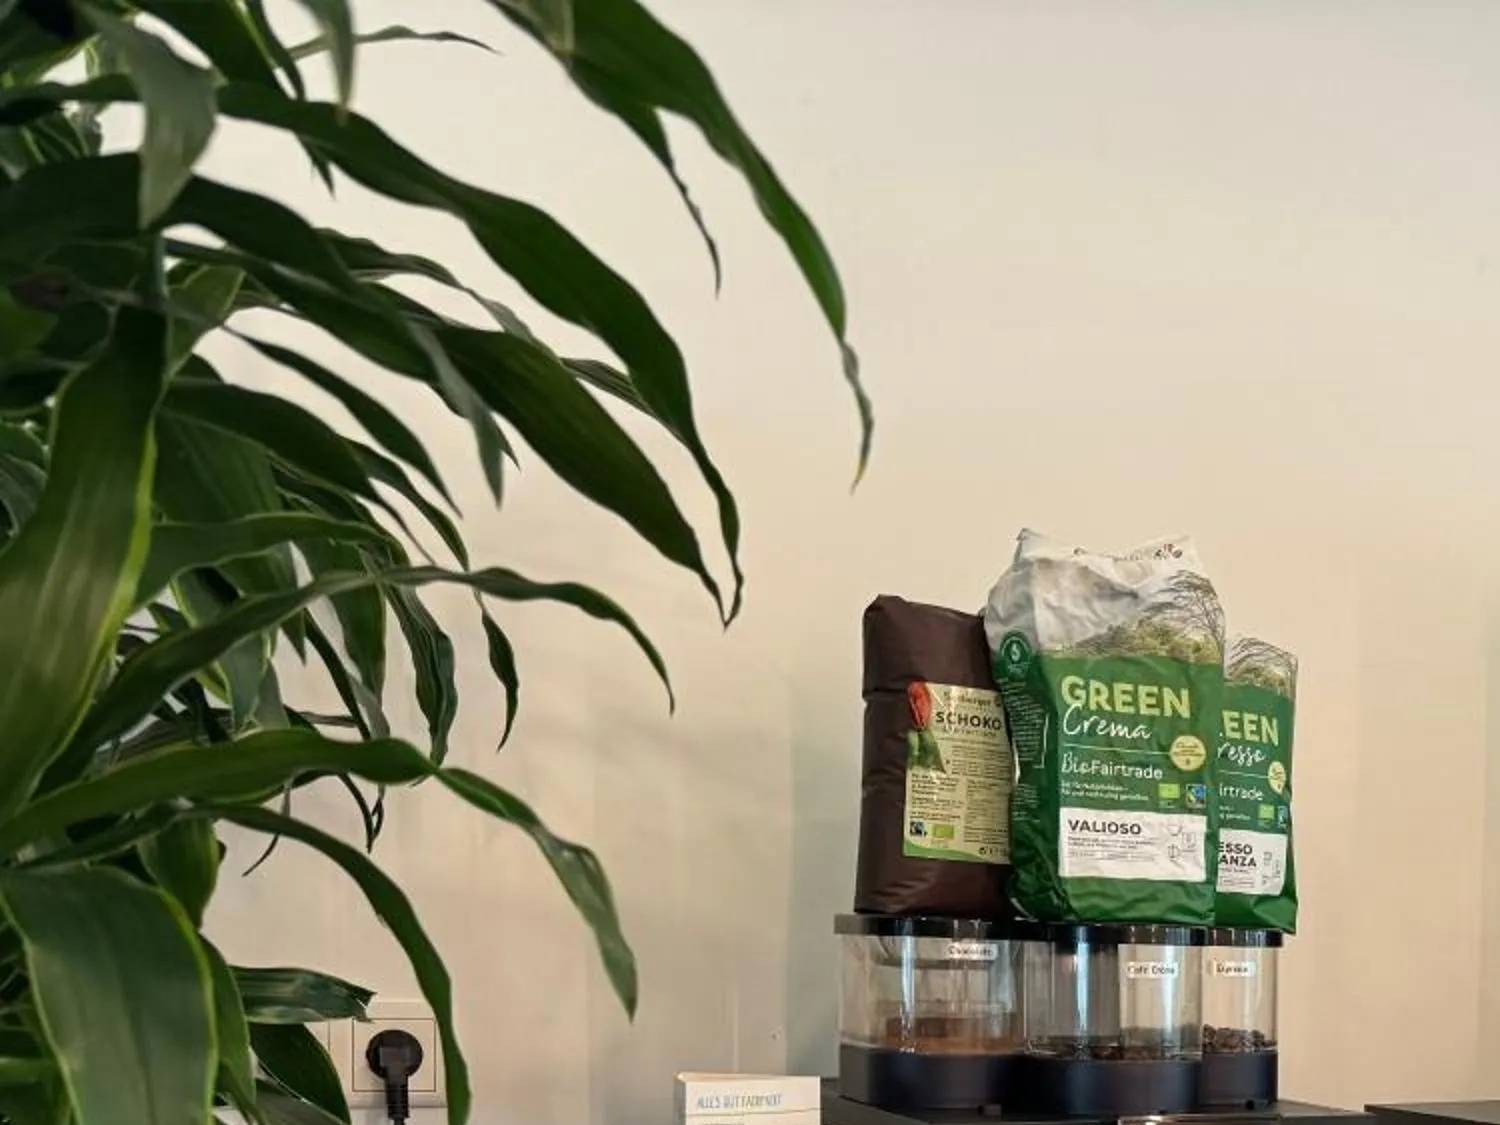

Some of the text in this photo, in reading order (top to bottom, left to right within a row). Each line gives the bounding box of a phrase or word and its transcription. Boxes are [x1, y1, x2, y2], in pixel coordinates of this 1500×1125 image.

[1061, 675, 1191, 719] GREEN
[936, 711, 1002, 731] SCHOKO
[1063, 703, 1153, 739] Crema
[1219, 709, 1279, 746] EEN
[1068, 819, 1142, 835] VALIOSO
